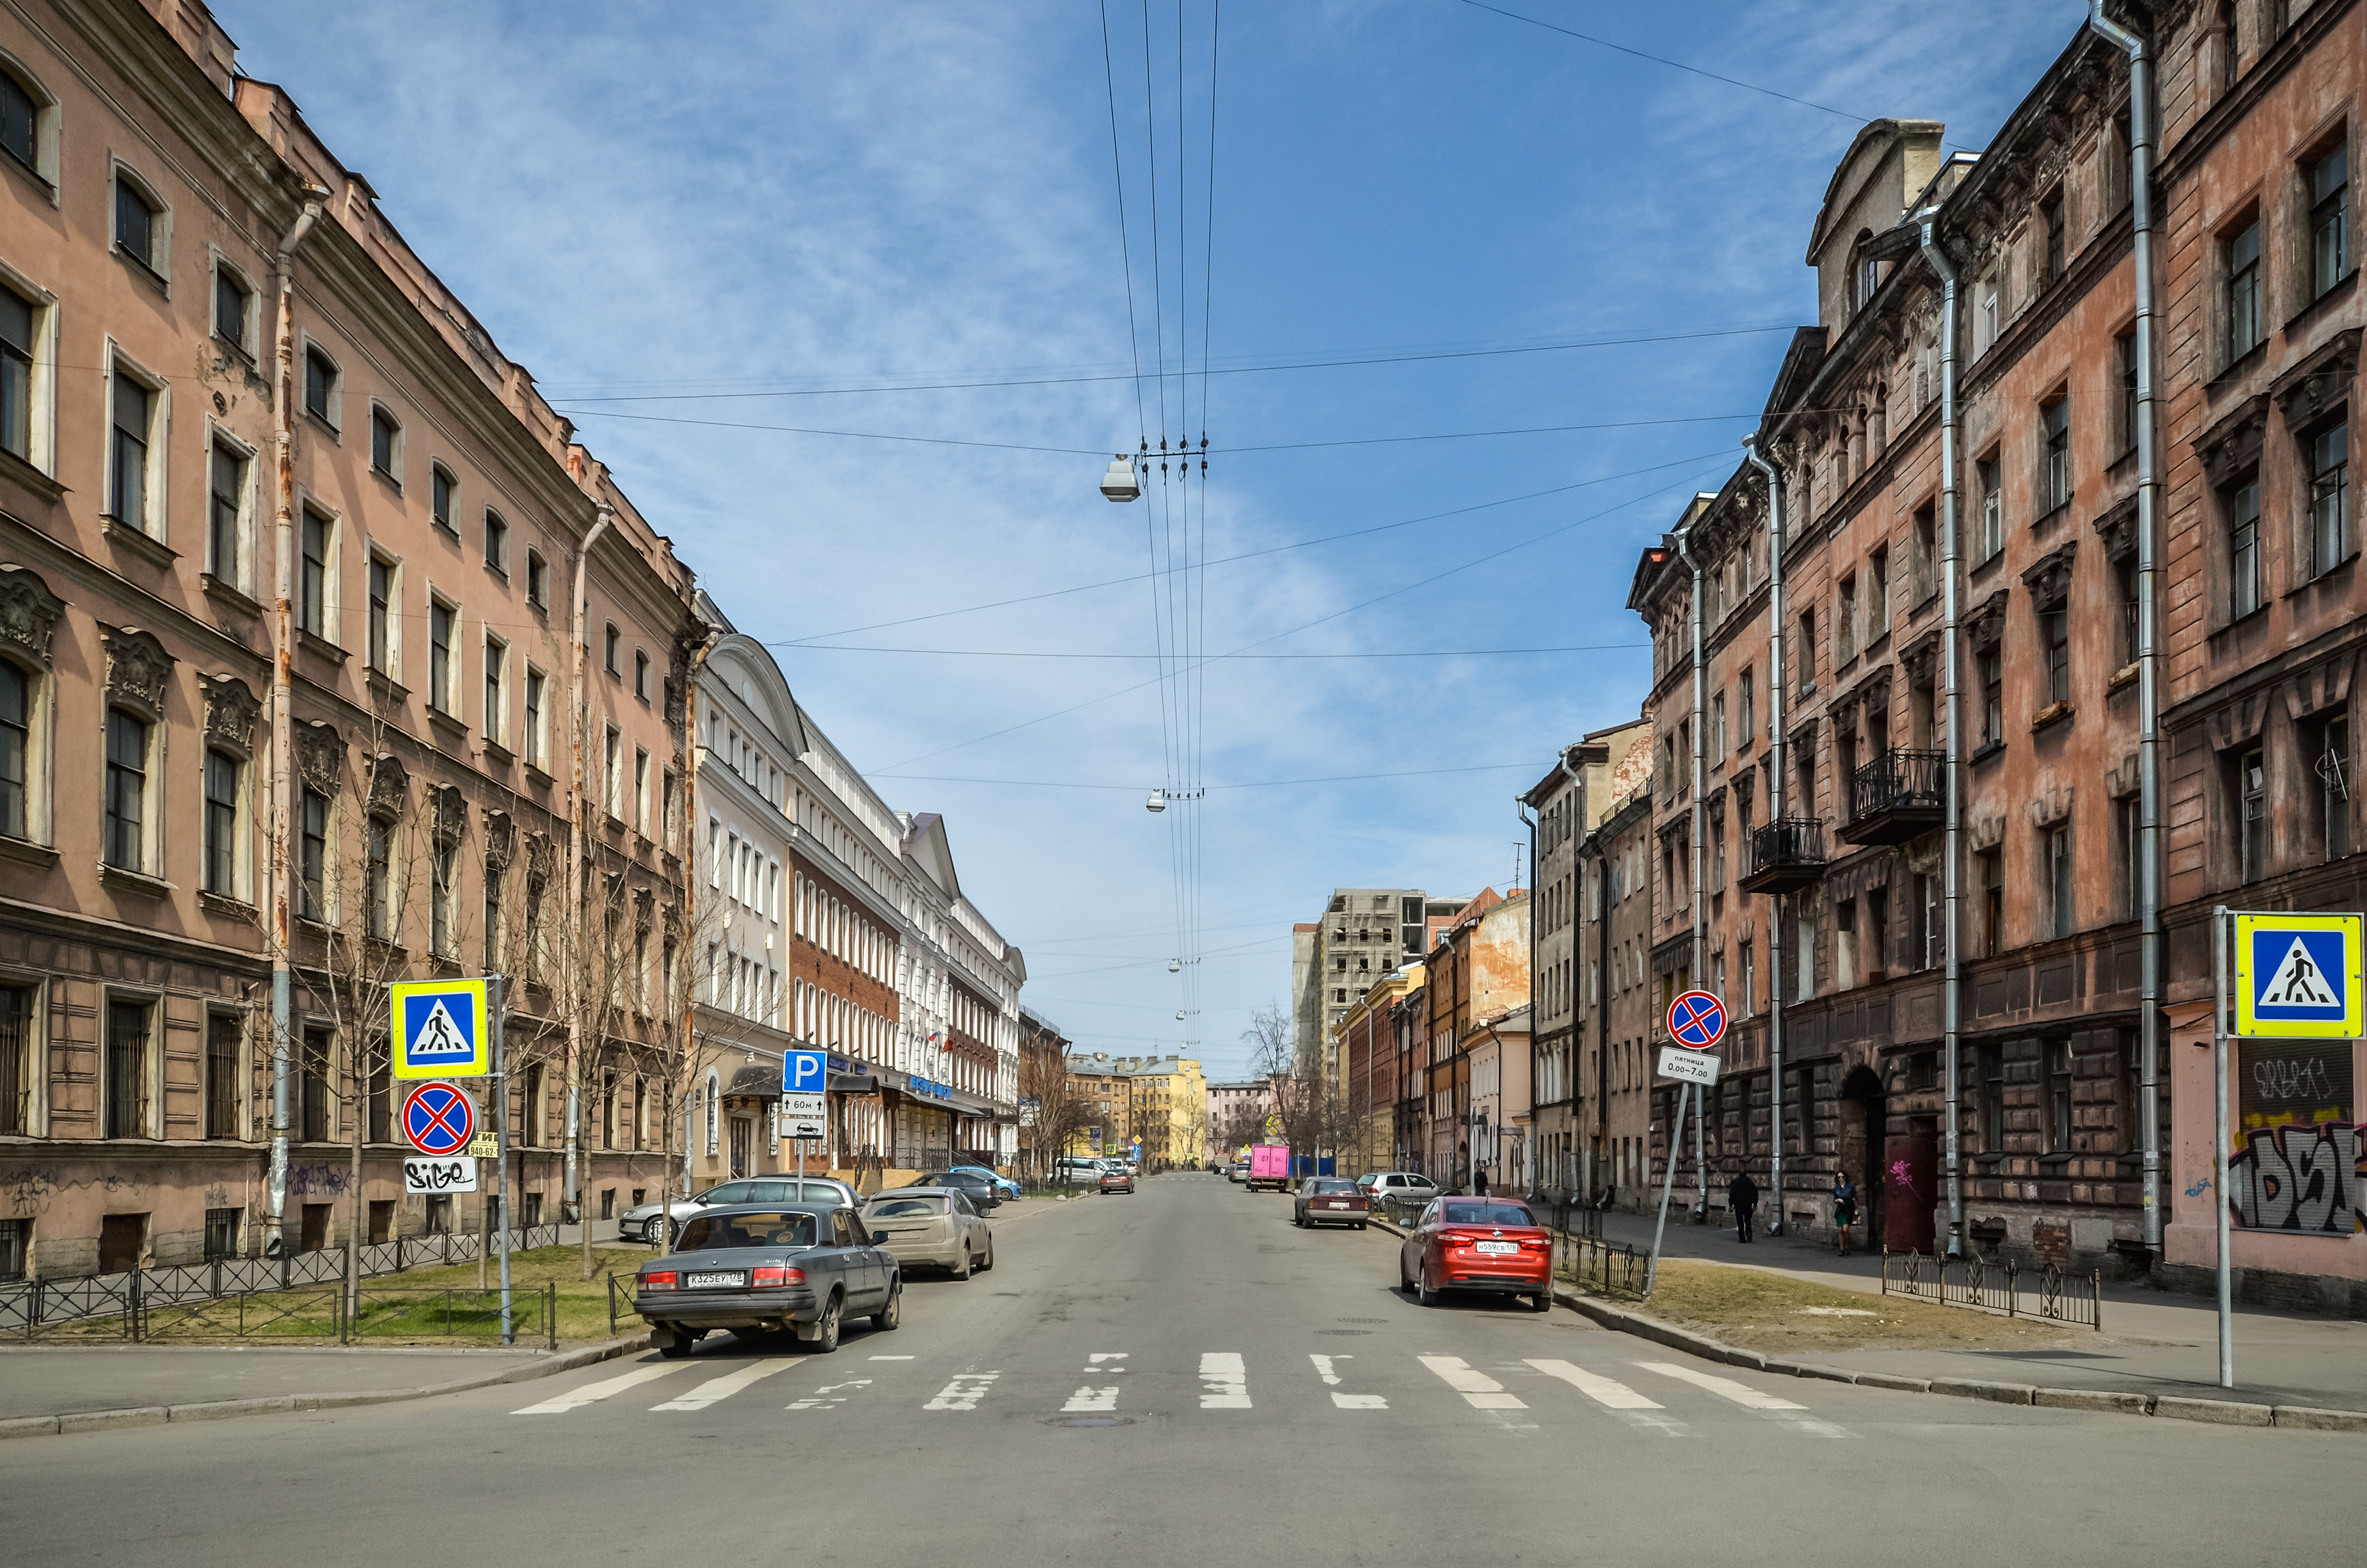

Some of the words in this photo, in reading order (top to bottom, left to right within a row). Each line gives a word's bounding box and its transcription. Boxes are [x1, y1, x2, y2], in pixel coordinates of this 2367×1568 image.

[1674, 1056, 1704, 1066] пятница
[795, 1055, 819, 1088] P
[470, 1146, 498, 1157] 940-62-
[692, 1273, 726, 1283] К325ЕУ
[728, 1272, 741, 1280] 178
